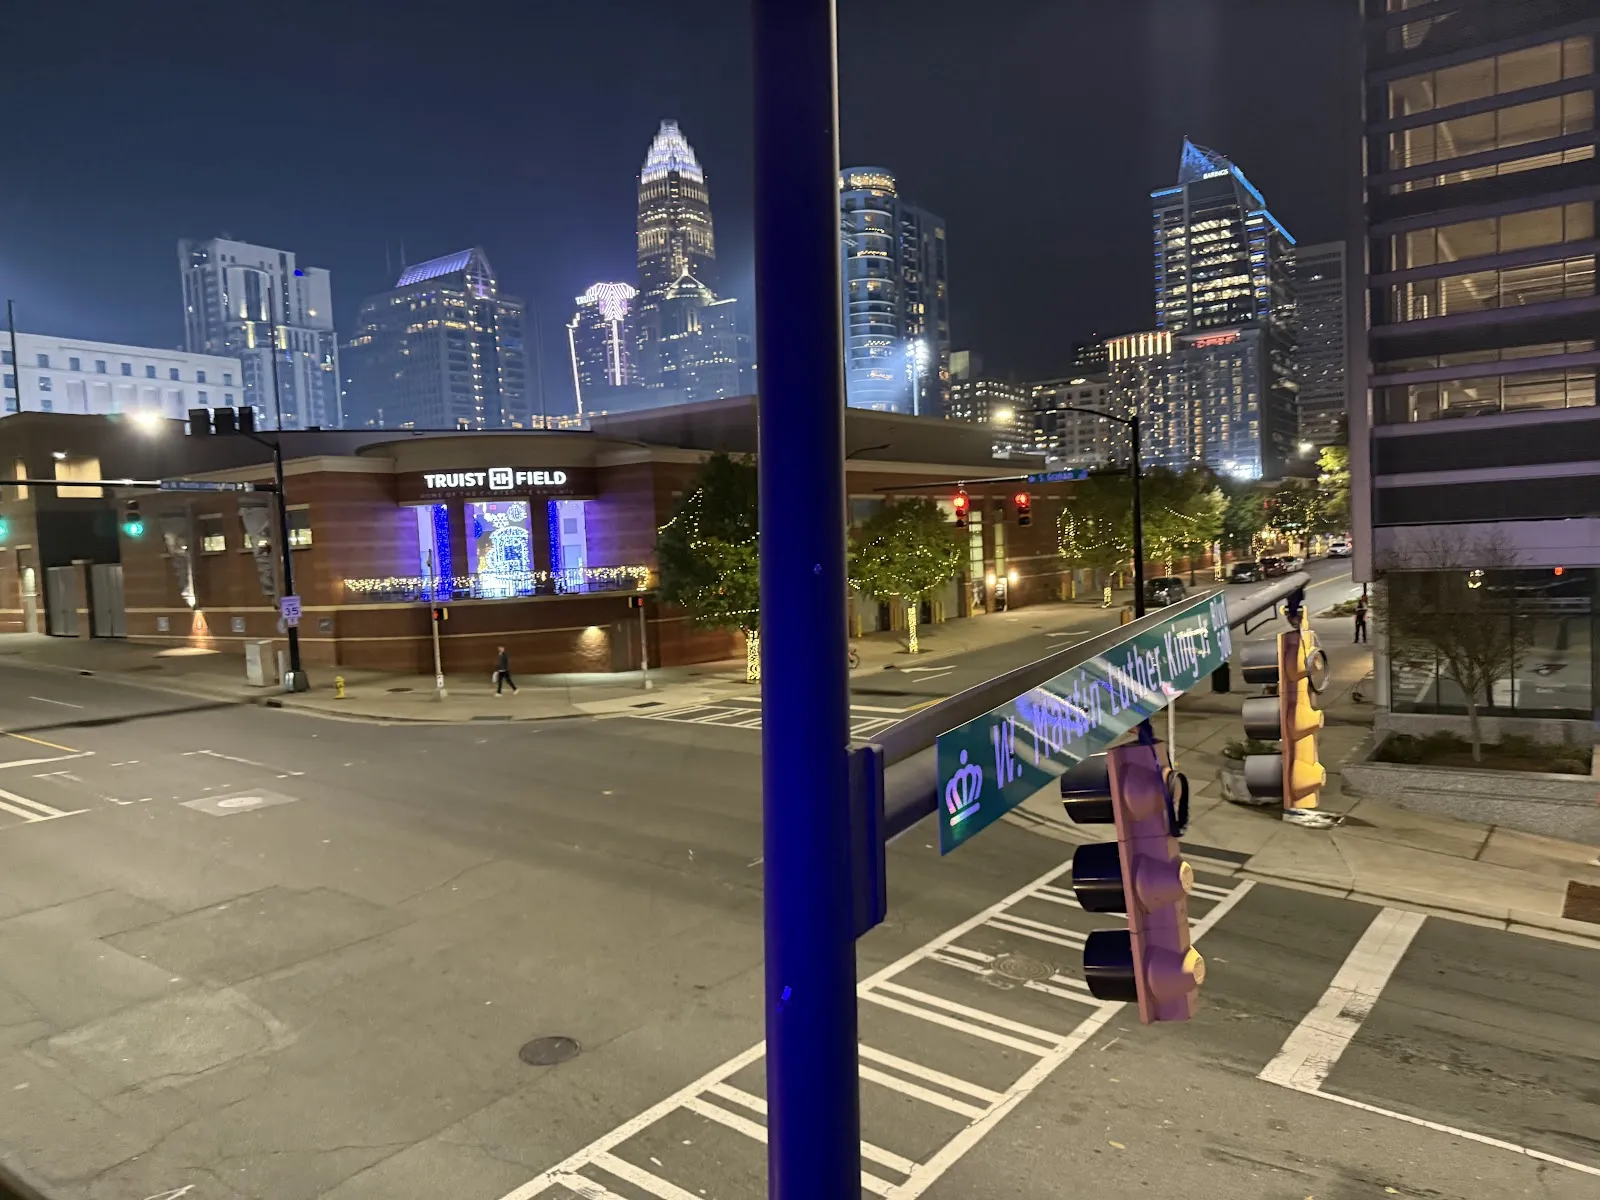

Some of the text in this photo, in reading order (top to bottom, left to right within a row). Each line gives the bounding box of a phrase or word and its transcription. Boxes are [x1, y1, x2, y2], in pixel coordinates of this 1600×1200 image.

[1203, 169, 1228, 179] BARINGS
[424, 471, 567, 488] TRUIST FIELD
[285, 607, 299, 616] 35
[993, 715, 1022, 789] W.
[1032, 670, 1102, 766] Martin
[1107, 645, 1162, 716] Luther
[1163, 623, 1199, 678] King
